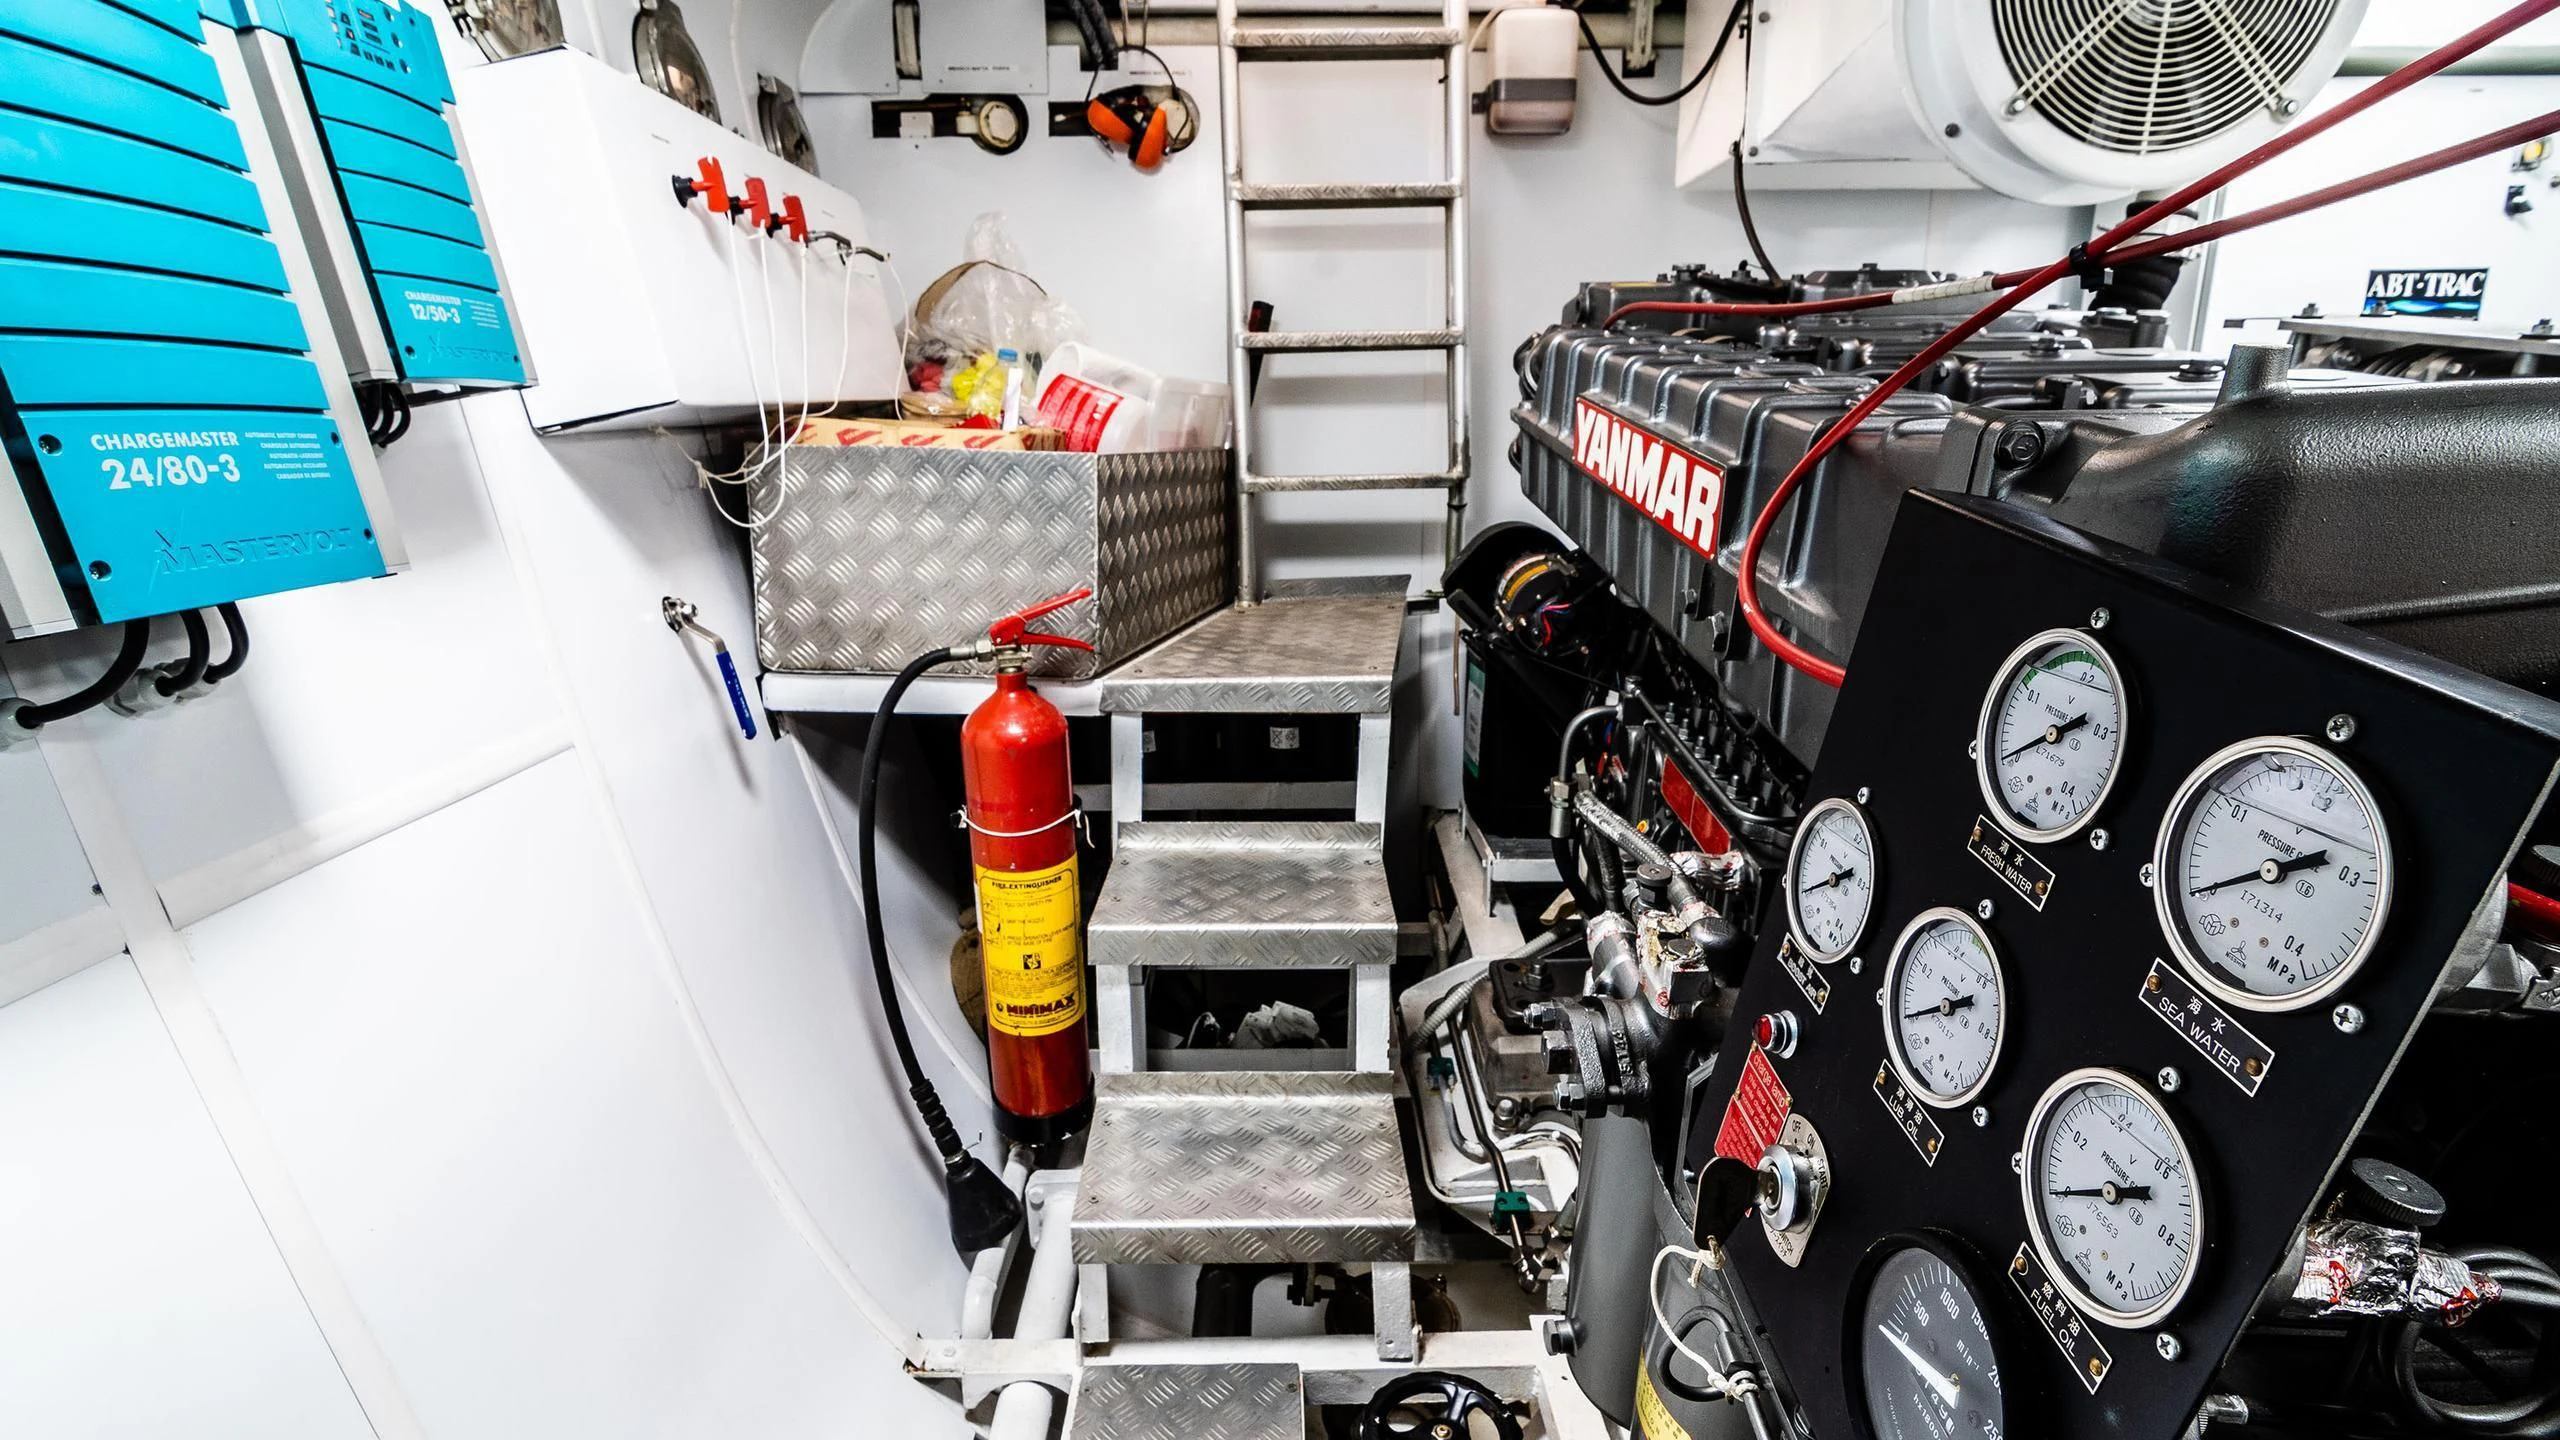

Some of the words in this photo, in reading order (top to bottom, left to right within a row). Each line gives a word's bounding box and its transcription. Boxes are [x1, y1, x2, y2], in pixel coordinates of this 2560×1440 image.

[408, 303, 461, 325] 12/50-3
[90, 431, 240, 451] CHARGEMASTER
[101, 453, 241, 490] 24/80-3
[1576, 401, 1721, 552] YANMAR
[152, 527, 352, 577] MASTERVOLT
[2028, 689, 2040, 704] 0.1
[2044, 703, 2069, 723] PRESSURE
[2093, 723, 2108, 740] 0.3
[2060, 780, 2075, 798] 0.4
[2231, 804, 2248, 823] 0.1
[2257, 829, 2296, 858] PRESSURE
[1980, 844, 2005, 871] FRESH
[2005, 864, 2032, 894] WATER
[2338, 865, 2360, 888] 0.3
[2284, 935, 2305, 957] 0.4
[1922, 962, 1933, 979] 0.2
[1940, 975, 1961, 999] PRESSURE
[1006, 992, 1075, 1015] MINIMAX
[1978, 1021, 1990, 1039] 0.8
[2158, 997, 2185, 1028] SEA
[2190, 1022, 2241, 1073] WATER
[1753, 1054, 1772, 1087] charge
[1771, 1081, 1785, 1108] lamp
[1791, 1119, 1802, 1134] OFF
[1888, 1095, 1905, 1121] LUB.
[1906, 1120, 1918, 1141] OIL
[1806, 1132, 1816, 1150] ON
[2073, 1130, 2088, 1151] 0.2
[1817, 1158, 1828, 1189] START
[2101, 1151, 2130, 1184] PRESSURE
[2157, 1224, 2175, 1247] 0.8
[1913, 1300, 1930, 1327] 500
[1939, 1287, 1960, 1320] 1000
[2030, 1288, 2055, 1329] FUEL
[2059, 1328, 2076, 1358] OIL
